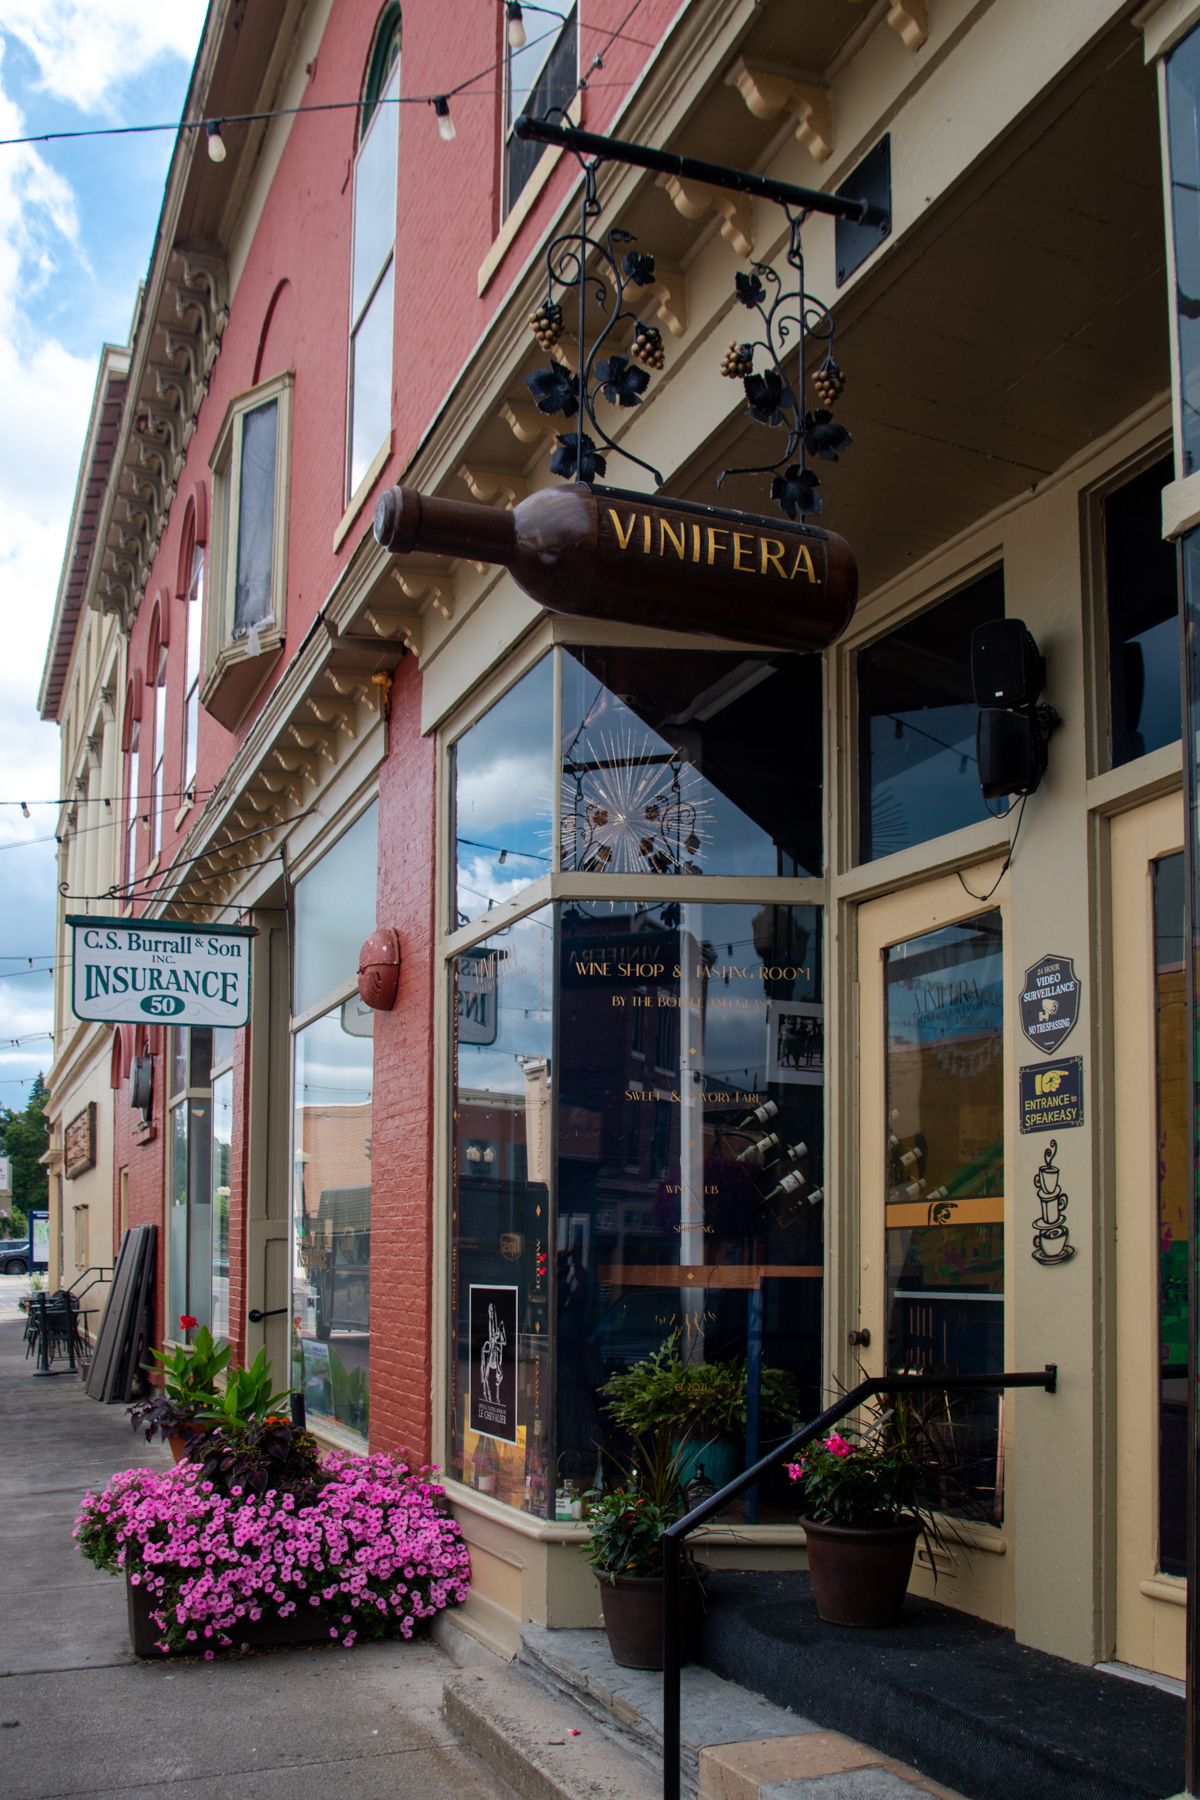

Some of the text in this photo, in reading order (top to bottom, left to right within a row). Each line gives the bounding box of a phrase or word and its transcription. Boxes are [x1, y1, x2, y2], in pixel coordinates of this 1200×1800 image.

[608, 508, 822, 584] VINIFERA.
[84, 930, 242, 957] C.S. Burrall & Son
[152, 954, 176, 964] INC.
[575, 962, 811, 981] WINE SHOP & TASTING ROOM
[1044, 963, 1061, 974] HOUR
[84, 964, 239, 1007] INSURANCE
[1036, 973, 1061, 988] VIDEO
[1023, 981, 1075, 1003] SURVEILLANCE
[150, 996, 176, 1014] 50
[612, 996, 773, 1010] BY THE BOTTLE AND GLASS
[1028, 1018, 1070, 1035] NO TRESPASSING
[670, 1090, 681, 1103] &
[735, 1091, 763, 1104] FARE
[1025, 1094, 1070, 1111] ENTRANCE
[1025, 1107, 1078, 1127] SPEAKEASY
[692, 1184, 719, 1195] CLUB
[687, 1201, 698, 1213] &
[673, 1225, 715, 1234] SHIPPING
[478, 1408, 507, 1425] LE CHEVALIER
